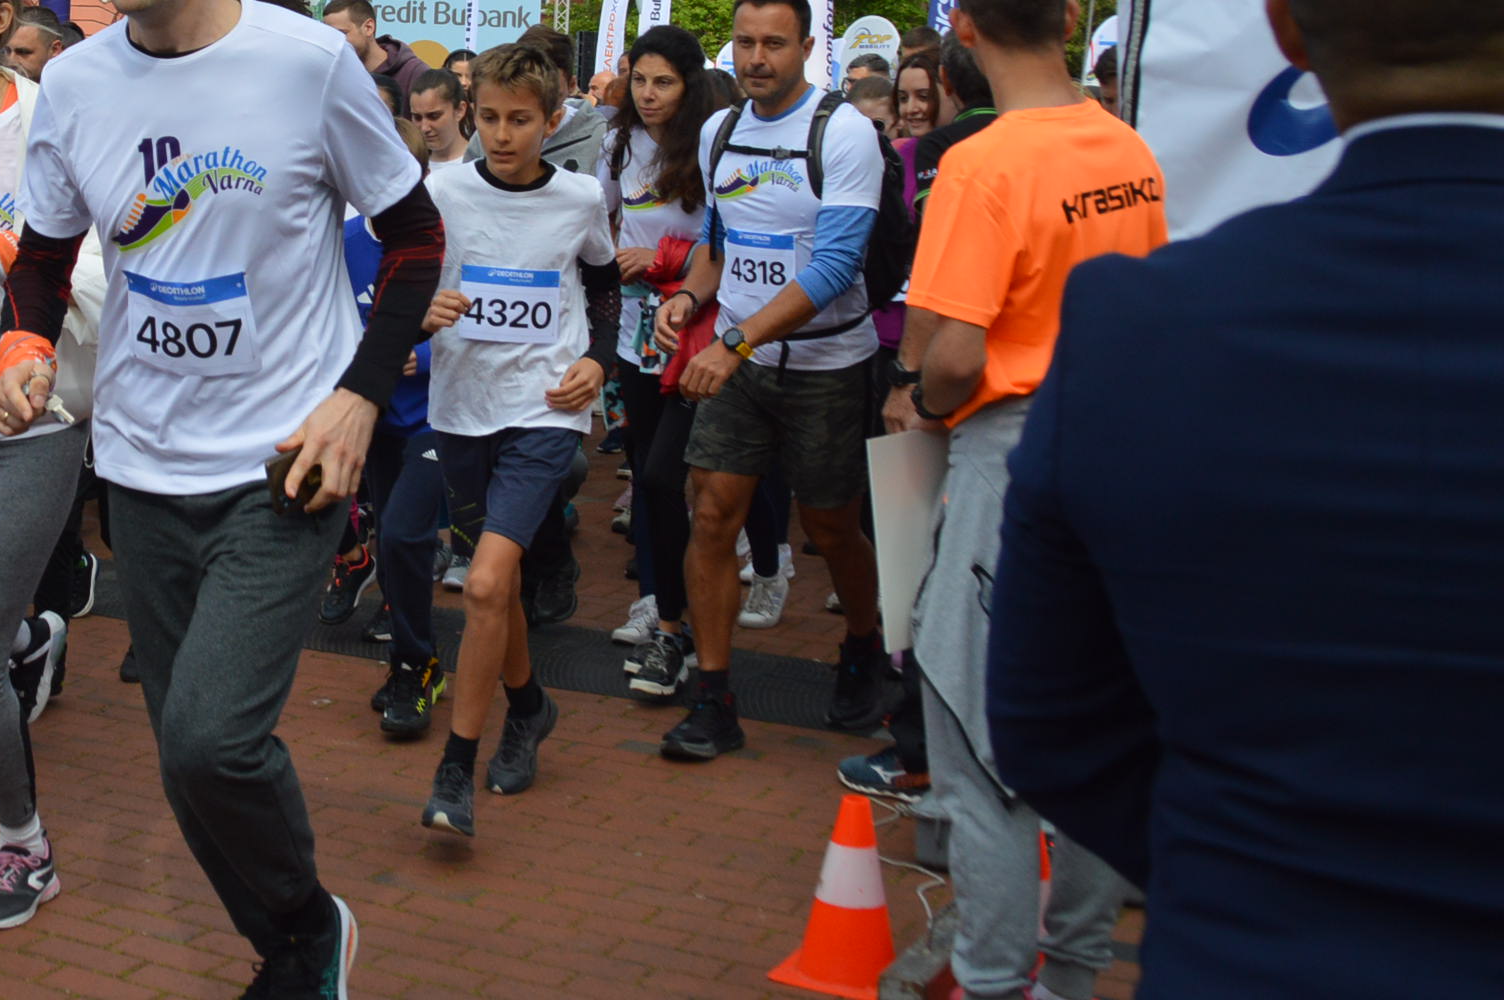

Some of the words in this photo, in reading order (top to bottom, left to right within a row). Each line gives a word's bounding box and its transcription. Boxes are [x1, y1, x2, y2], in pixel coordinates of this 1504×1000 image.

[372, 0, 427, 25] redit
[434, 1, 532, 29] Bubank
[138, 136, 181, 189] 10
[153, 146, 267, 203] Marathon
[202, 169, 263, 195] Varna
[730, 256, 786, 286] 4318
[464, 297, 552, 330] 4320
[137, 315, 242, 359] 4807
